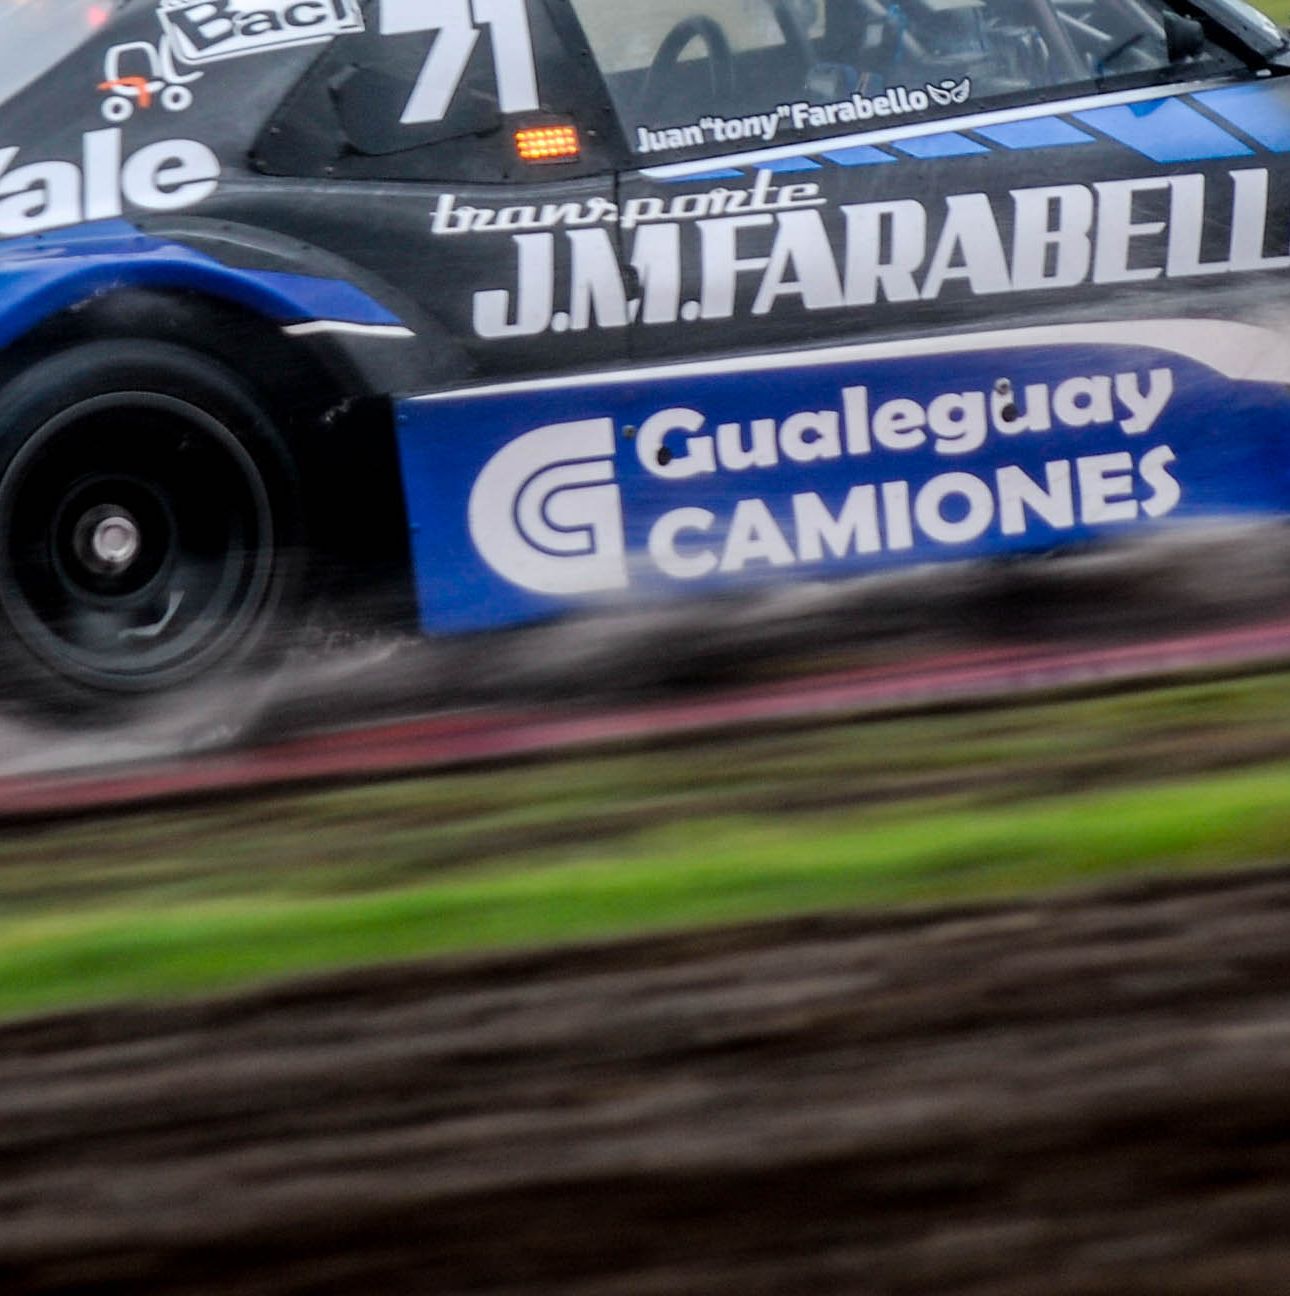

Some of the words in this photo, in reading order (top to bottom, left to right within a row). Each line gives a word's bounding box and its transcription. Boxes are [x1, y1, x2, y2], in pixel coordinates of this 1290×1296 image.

[429, 169, 829, 235] transporte
[635, 366, 1175, 480] Gualeguay
[647, 444, 1183, 580] CAMIONES
